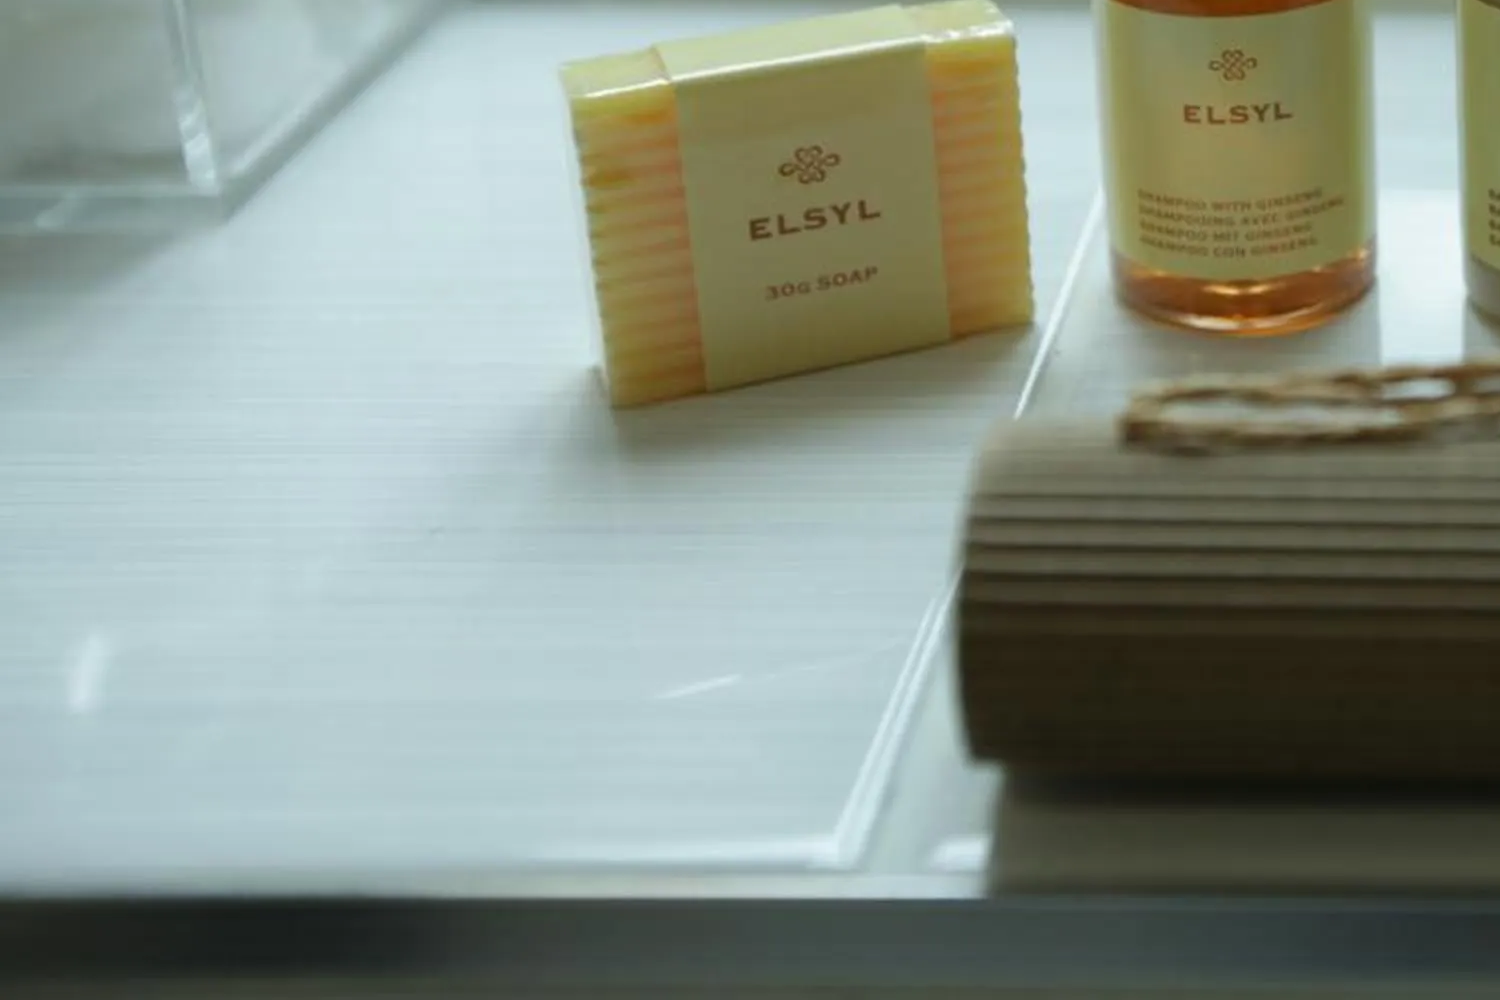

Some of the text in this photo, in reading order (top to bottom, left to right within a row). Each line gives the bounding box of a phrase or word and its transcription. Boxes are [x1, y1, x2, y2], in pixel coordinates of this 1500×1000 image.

[1183, 102, 1293, 125] ELSYL
[1211, 201, 1251, 212] WITH
[749, 199, 881, 241] ELSYL
[1213, 231, 1239, 242] MIT
[1213, 246, 1246, 257] CON
[816, 265, 878, 291] SOAP
